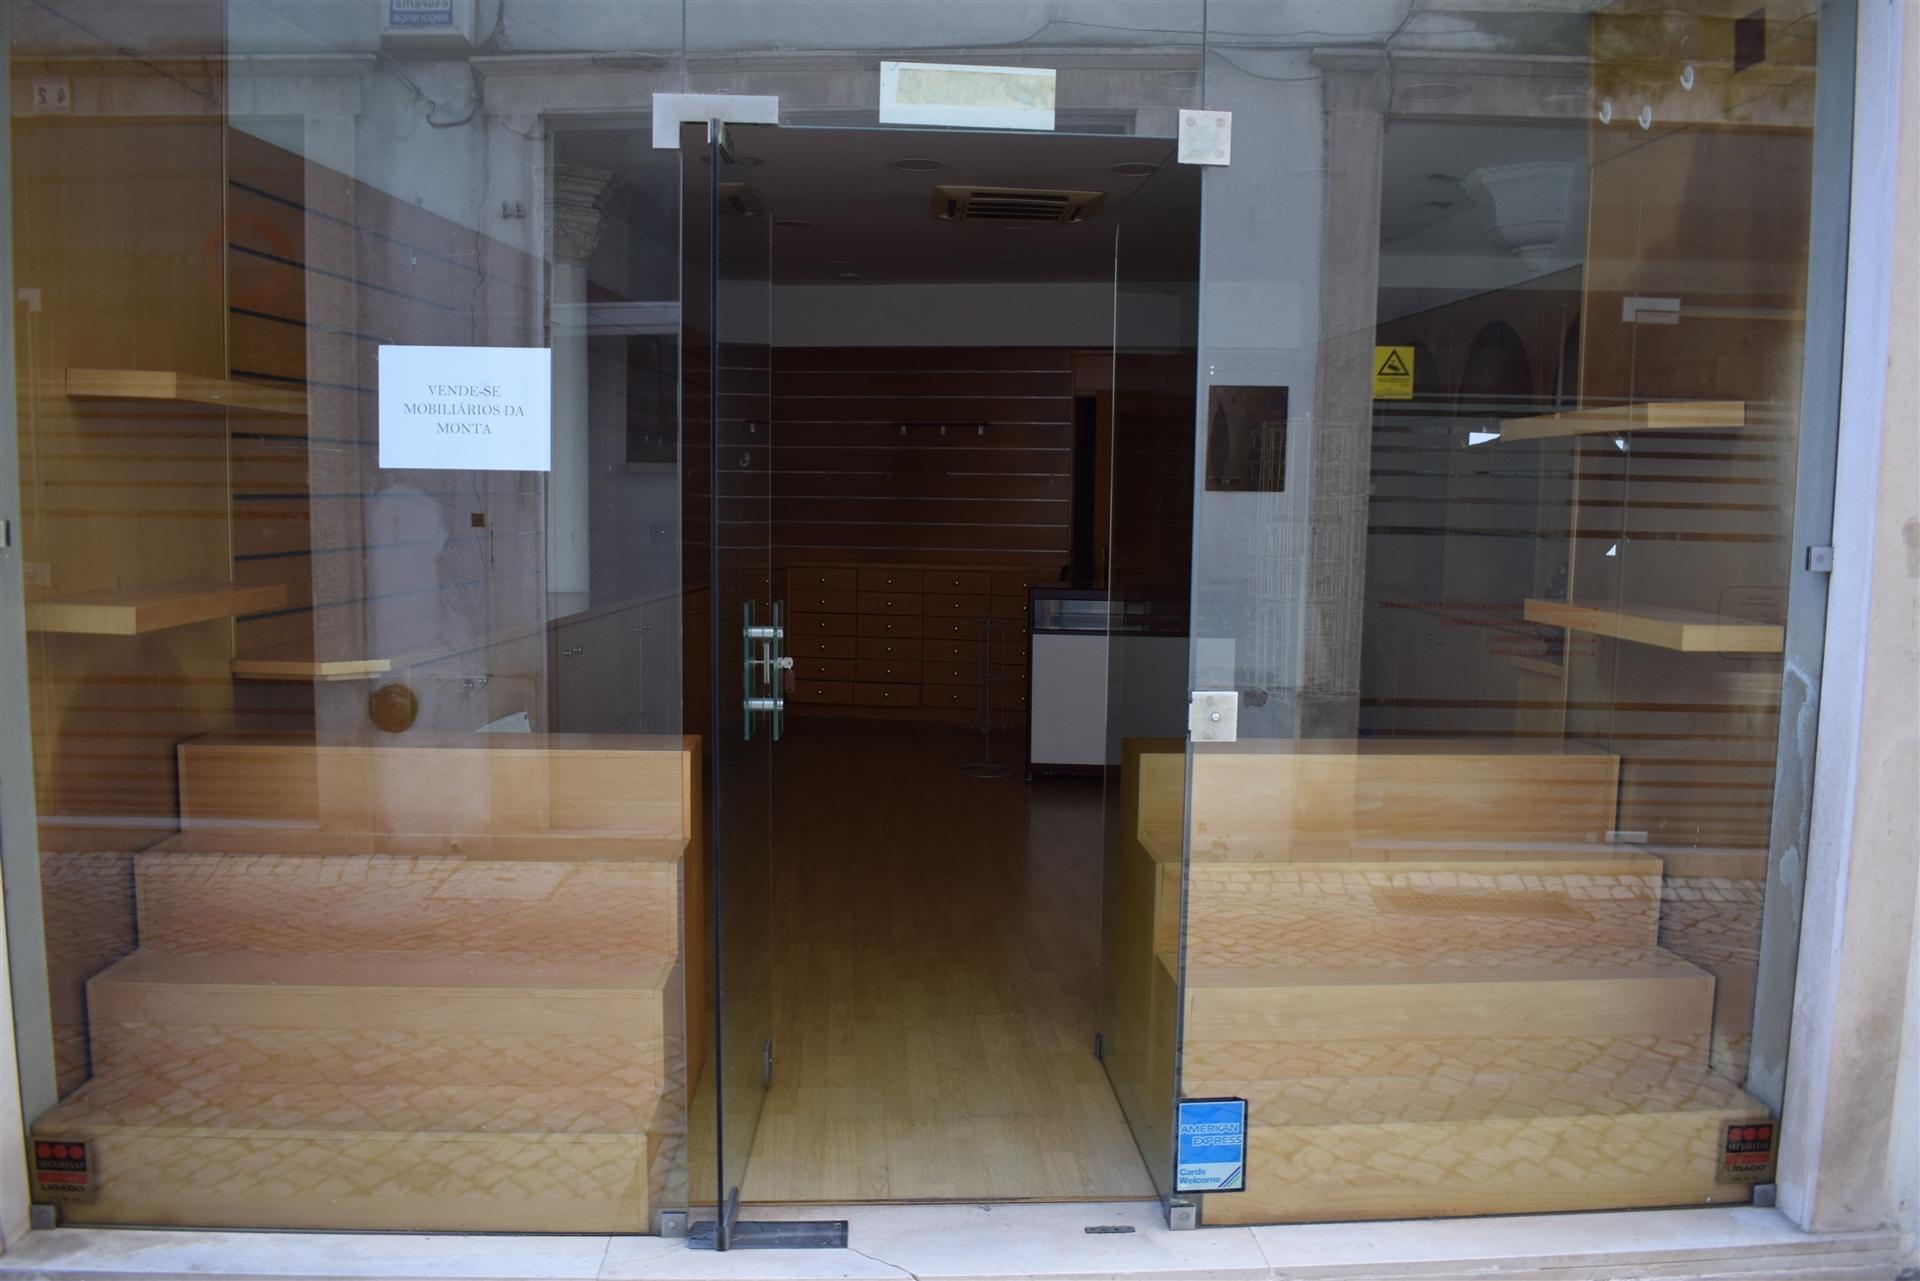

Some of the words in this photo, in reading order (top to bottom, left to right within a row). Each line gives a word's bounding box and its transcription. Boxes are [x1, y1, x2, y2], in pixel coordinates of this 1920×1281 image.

[427, 384, 501, 397] VENDE-SE
[404, 402, 501, 416] MOBILIÁRIOS
[504, 405, 525, 416] DA
[436, 422, 492, 434] MONTA
[1180, 1123, 1241, 1134] AMERICAN
[1192, 1135, 1242, 1147] EXPRESS
[1180, 1168, 1206, 1176] Cards
[1179, 1177, 1221, 1185] Welcome
[41, 1183, 86, 1193] LIGADO
